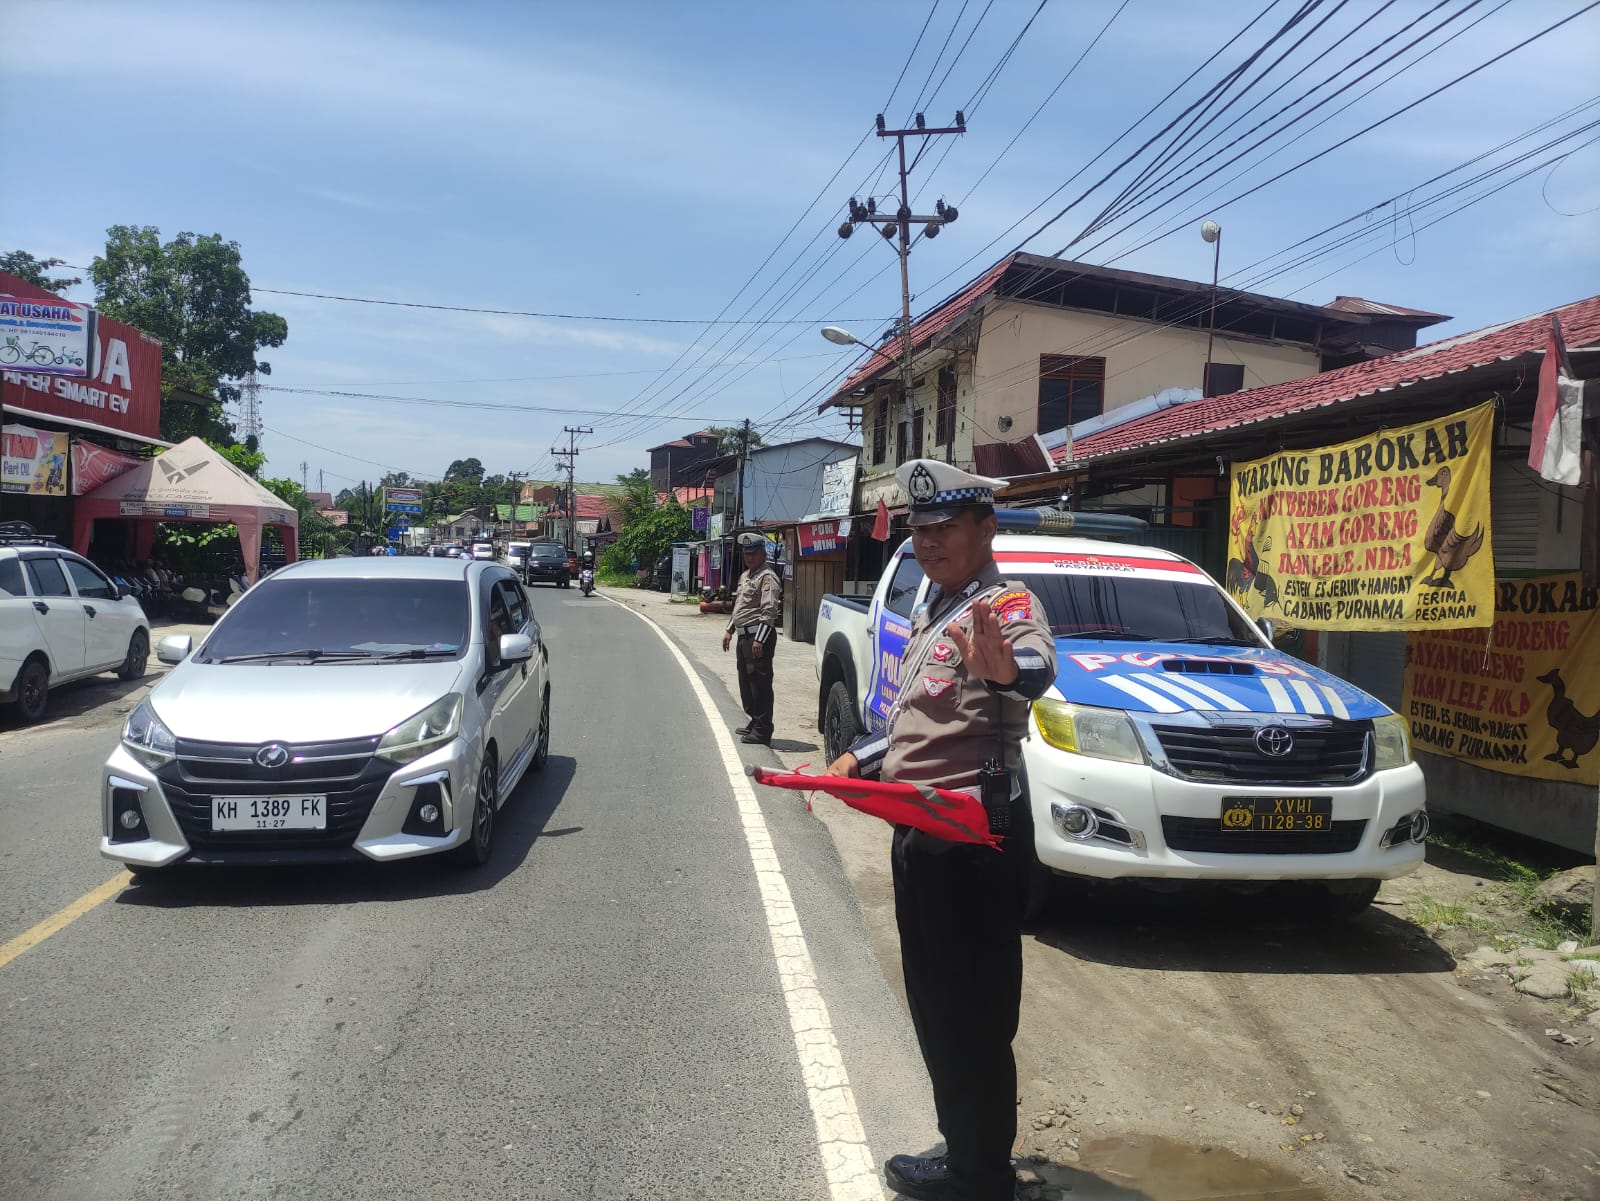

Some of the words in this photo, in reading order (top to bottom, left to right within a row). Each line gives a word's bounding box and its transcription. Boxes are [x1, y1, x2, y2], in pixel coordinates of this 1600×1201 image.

[0, 302, 19, 316] AT
[21, 303, 71, 321] USAHA
[54, 377, 108, 408] SMART
[109, 393, 130, 414] EV
[1236, 456, 1309, 497] WARUNG
[1318, 420, 1469, 485] BAROKAH
[1286, 487, 1340, 518] BEBEK
[1341, 473, 1422, 513] GORENG
[811, 523, 834, 537] POM
[1286, 520, 1336, 550] AYAM
[1339, 508, 1418, 546] GORENG
[812, 538, 837, 552] MINI
[1365, 543, 1412, 572] NILA
[1315, 580, 1326, 598] ES
[1417, 590, 1467, 606] TERIMA
[1495, 581, 1598, 614] ROKAH
[1283, 600, 1332, 621] CABANG
[1336, 598, 1404, 621] PURNAMA
[1415, 605, 1477, 622] PESANAN
[1494, 620, 1571, 651] GORENG
[881, 651, 903, 689] POL
[1068, 652, 1319, 682] POSI
[1414, 641, 1460, 673] AYAM
[1461, 648, 1526, 683] GORENG
[1412, 673, 1446, 701] IKAN
[1450, 680, 1490, 711] LELE
[1411, 720, 1455, 750] CABANG
[1458, 733, 1528, 765] PURNAMA
[217, 801, 237, 819] KH
[250, 800, 290, 818] 1389
[301, 798, 321, 817] FK
[1261, 815, 1324, 830] 1128-38
